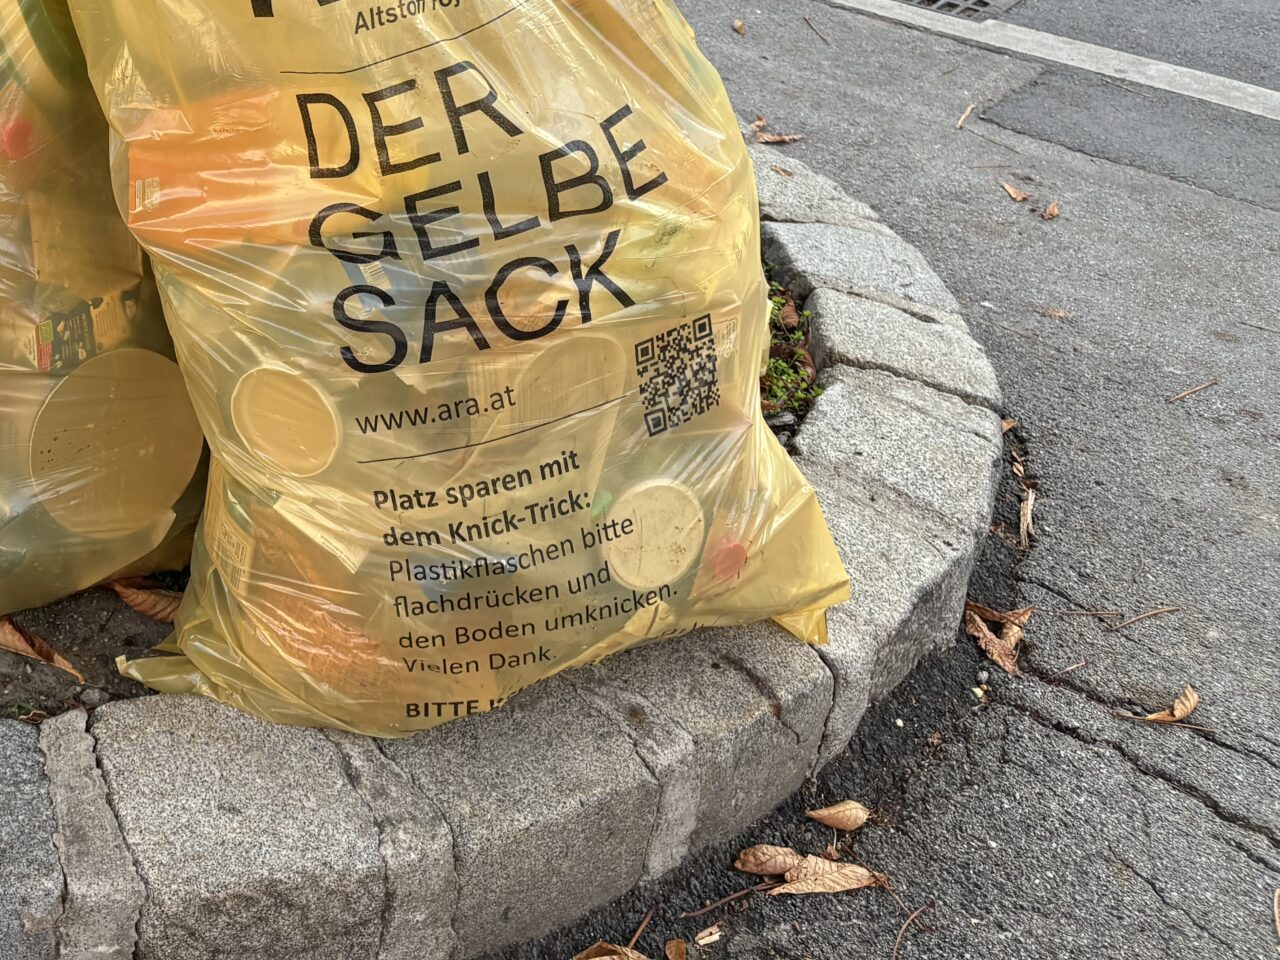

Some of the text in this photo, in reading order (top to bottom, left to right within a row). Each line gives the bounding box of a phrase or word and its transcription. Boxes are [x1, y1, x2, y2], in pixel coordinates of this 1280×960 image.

[297, 60, 523, 179] DER
[308, 104, 668, 264] GELBE
[332, 229, 636, 373] SACK
[356, 386, 517, 434] www.ara.at
[374, 450, 580, 511] Platz sparen mit
[383, 490, 592, 546] dem Knick-Trick:
[389, 515, 635, 582] Plastikflaschen bitte
[394, 562, 612, 618] flachdrücken und
[399, 629, 446, 649] den
[455, 620, 536, 642] Boden
[545, 584, 678, 632] umknicken.
[403, 646, 557, 675] Vielen Dank.
[406, 699, 480, 719] BITTE
